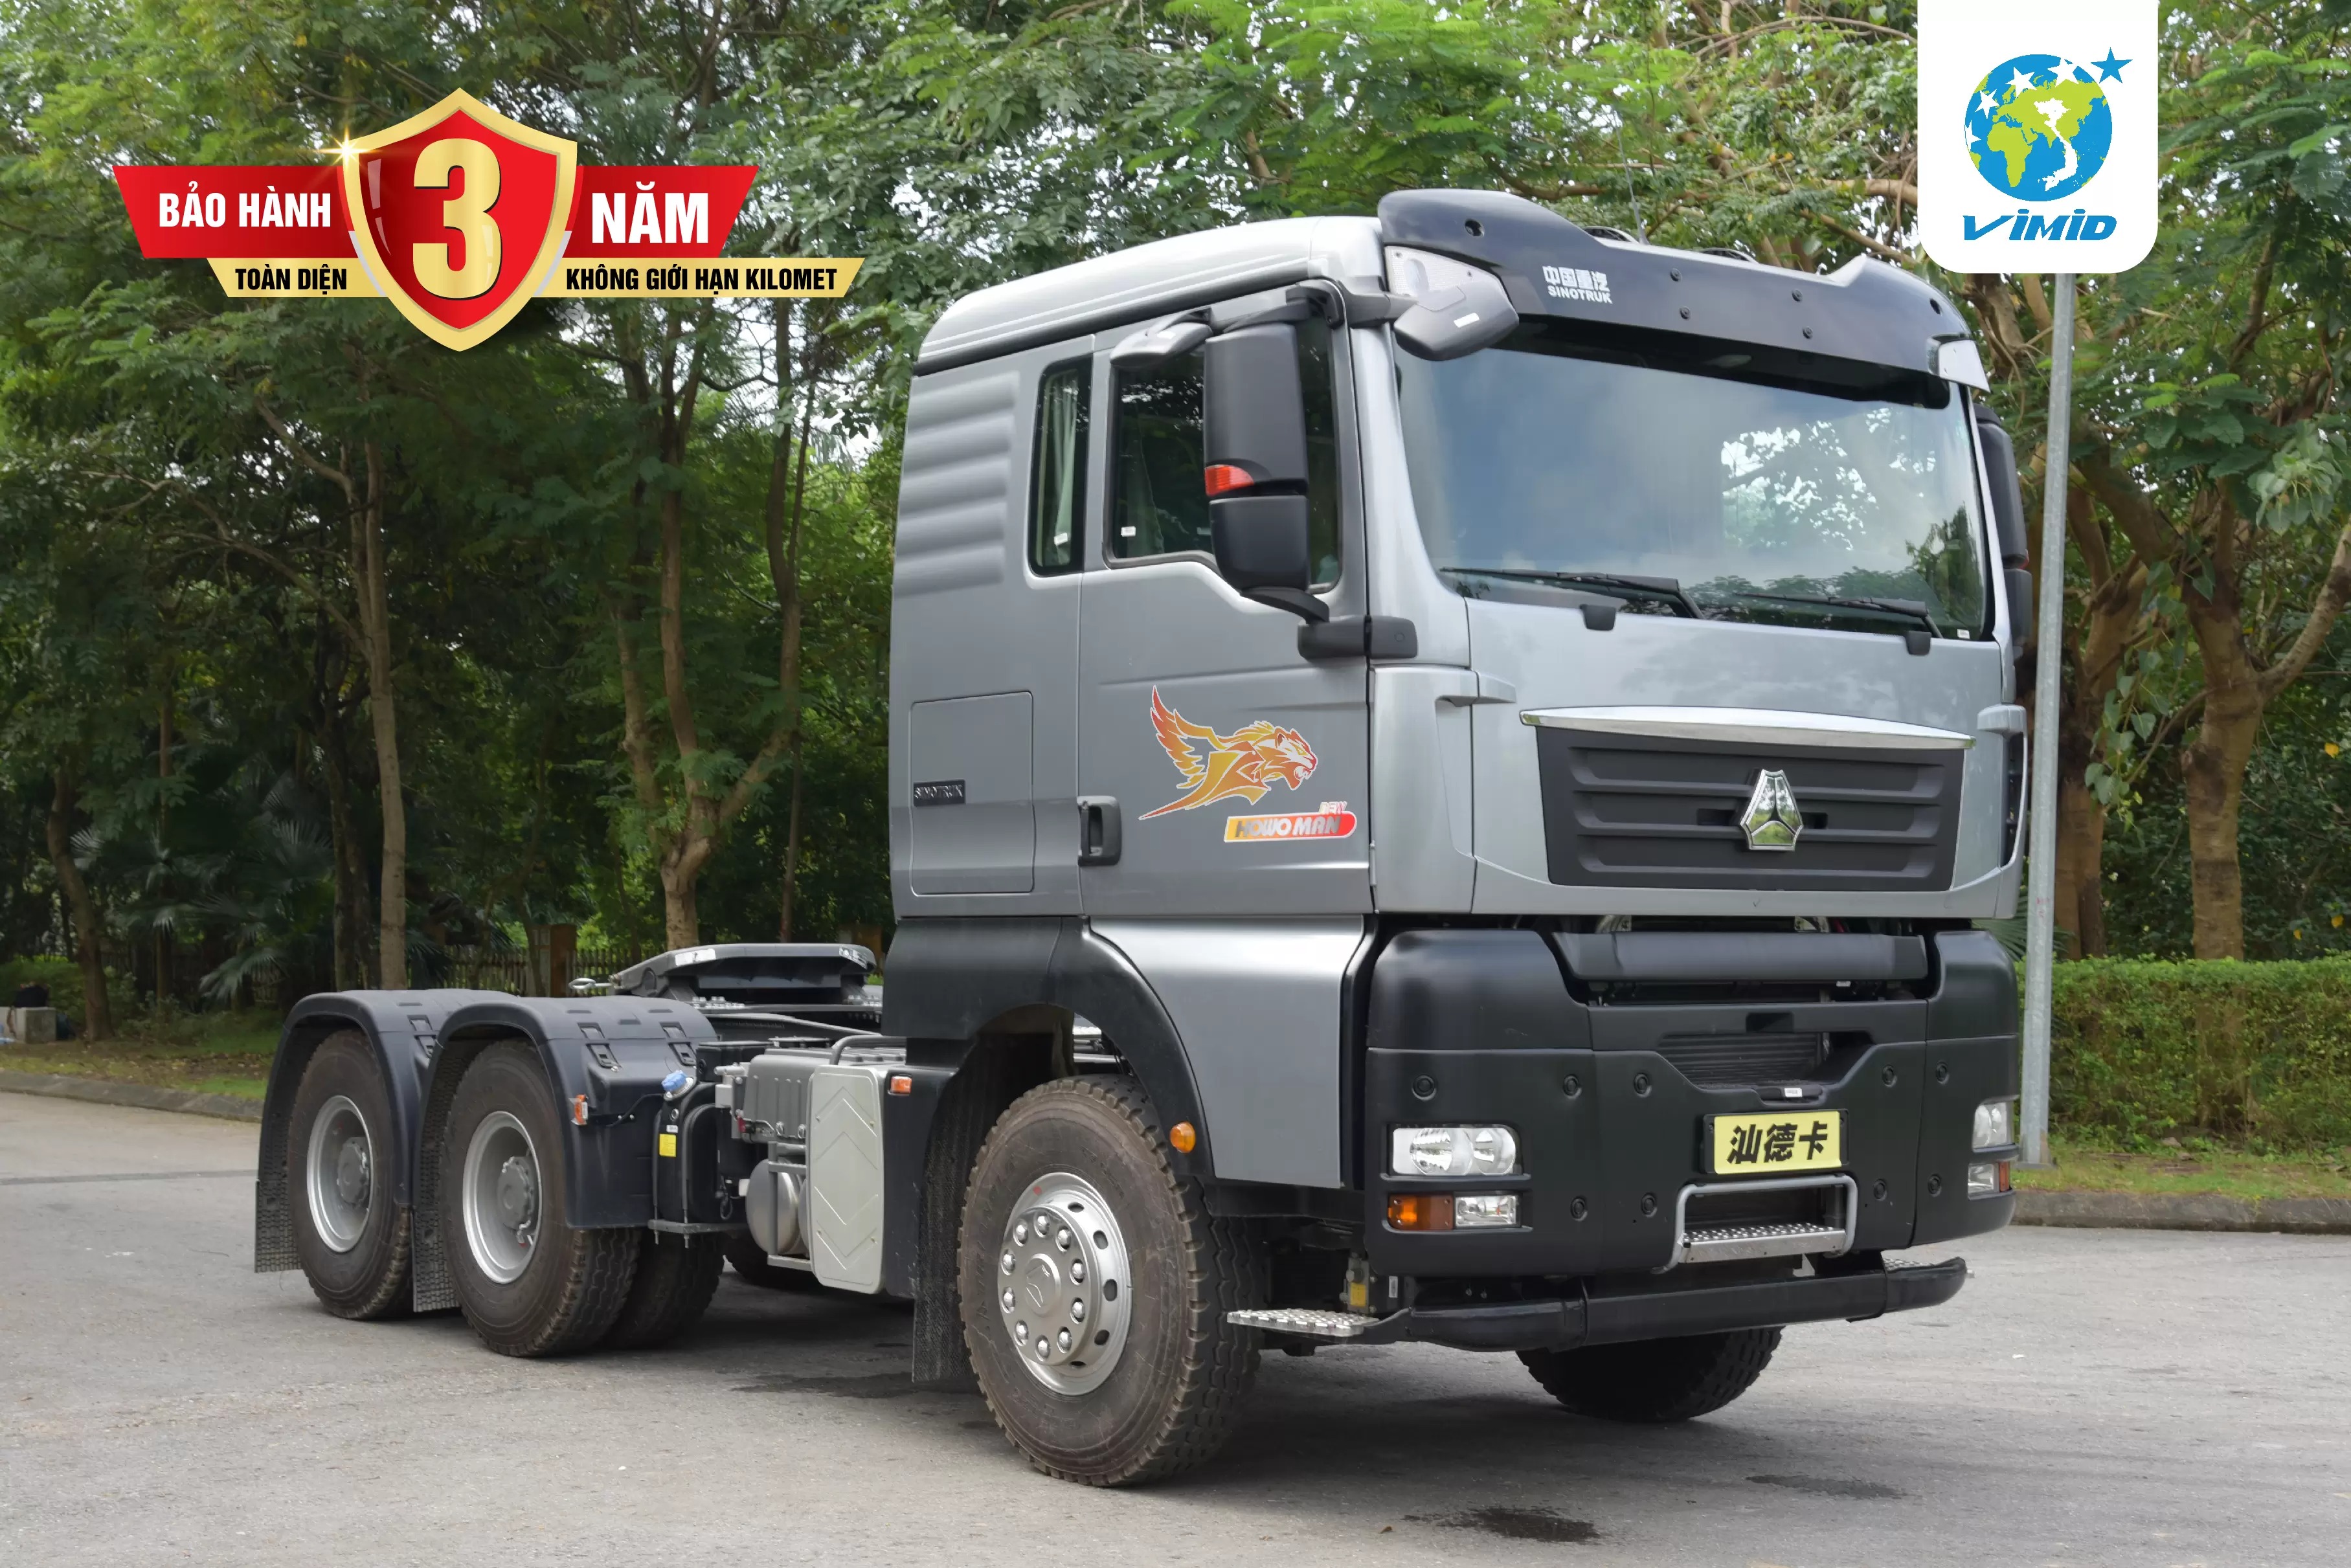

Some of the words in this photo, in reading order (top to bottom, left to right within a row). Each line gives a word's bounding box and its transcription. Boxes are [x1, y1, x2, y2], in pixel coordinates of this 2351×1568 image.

[1547, 286, 1613, 304] SINOTRUK
[1235, 818, 1292, 838] HOWO
[1292, 816, 1341, 836] MAN
[1726, 1121, 1828, 1165] 汕德卡
